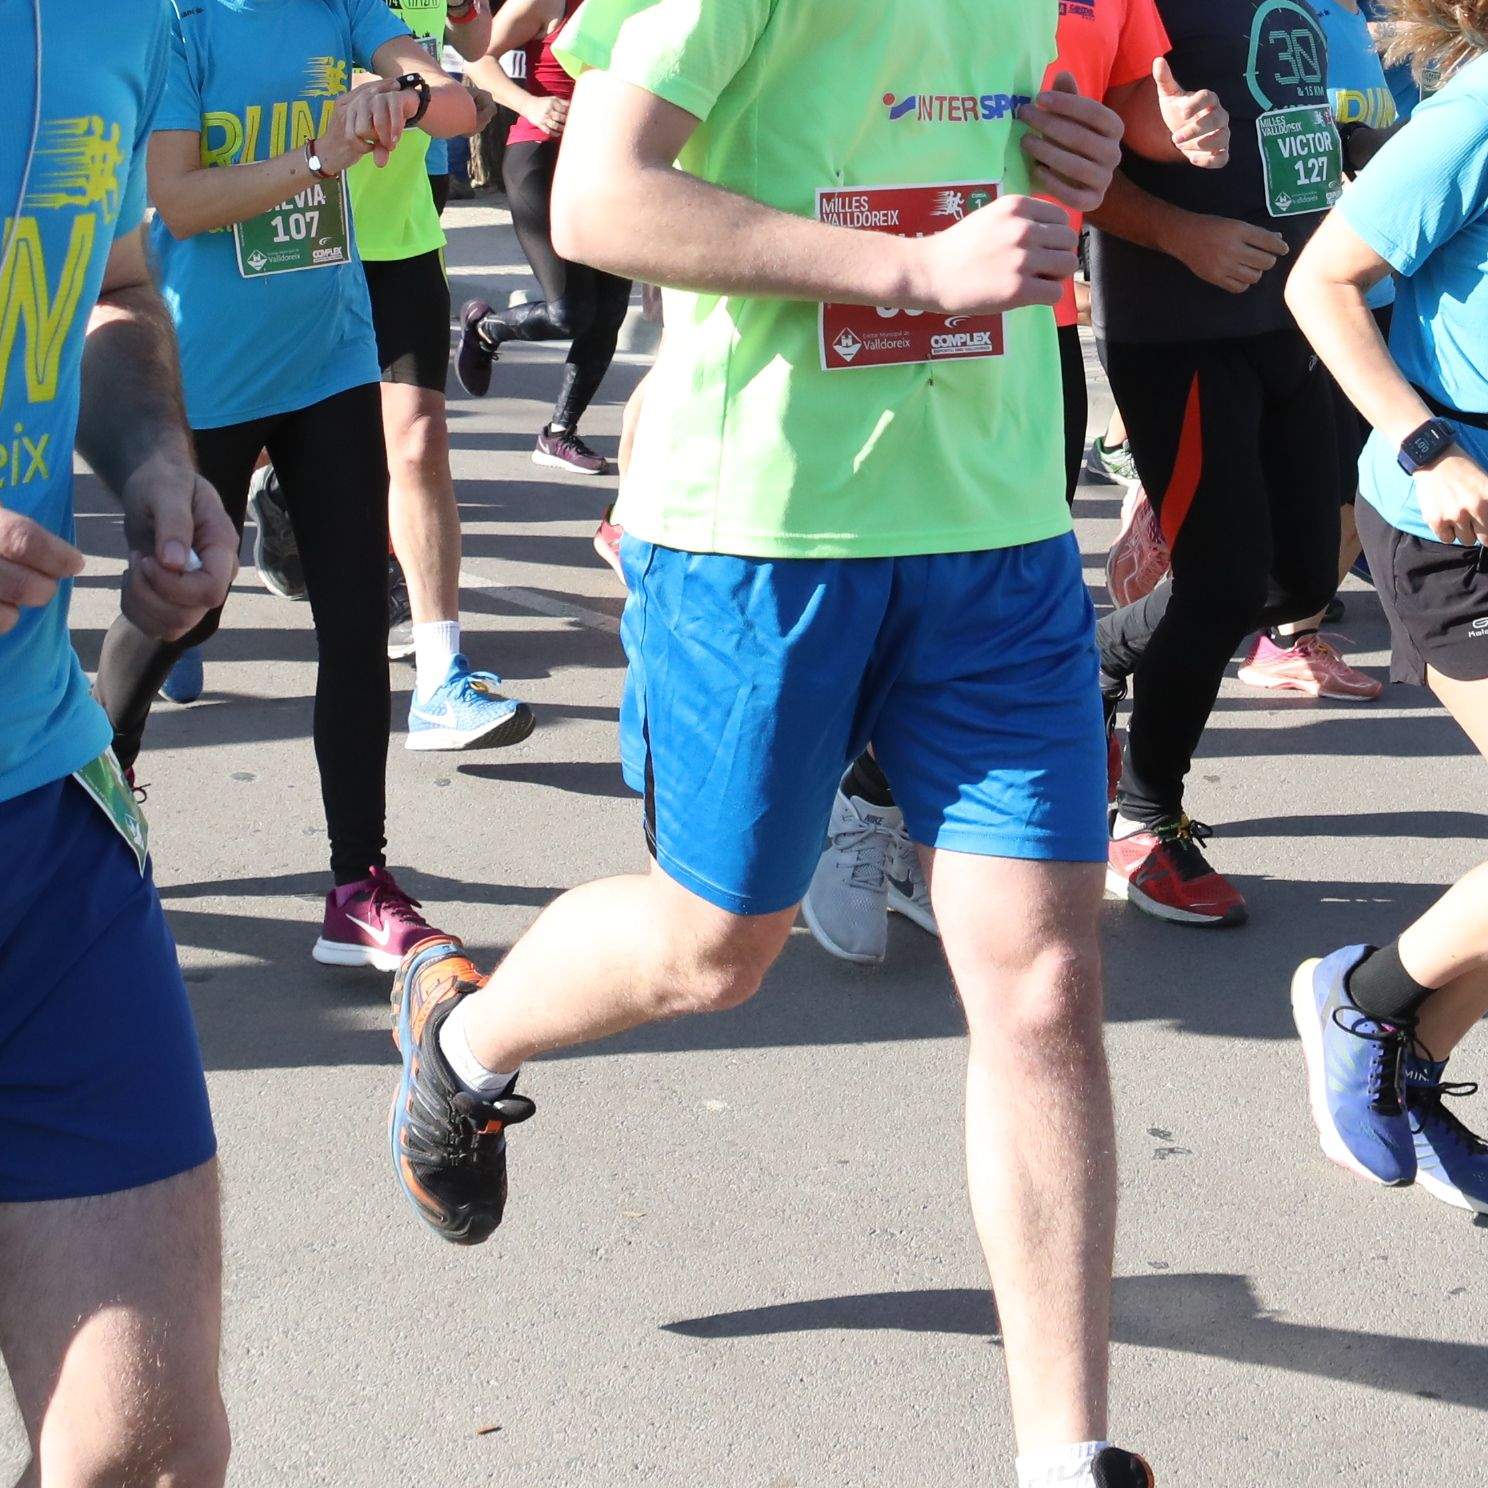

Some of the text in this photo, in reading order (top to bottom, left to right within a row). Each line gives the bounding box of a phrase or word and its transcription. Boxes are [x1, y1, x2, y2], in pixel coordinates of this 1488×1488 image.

[1269, 28, 1322, 85] 30
[1260, 115, 1286, 129] MILLES
[1277, 131, 1333, 159] VICTOR
[1294, 156, 1328, 186] 127
[265, 183, 327, 213] LVIA
[822, 195, 869, 213] MILLES
[270, 210, 321, 244] 107
[822, 210, 900, 228] VALLDOREIX
[312, 246, 343, 259] COMPLEX
[863, 338, 912, 351] Valldoreix
[930, 332, 992, 349] COMPLEX
